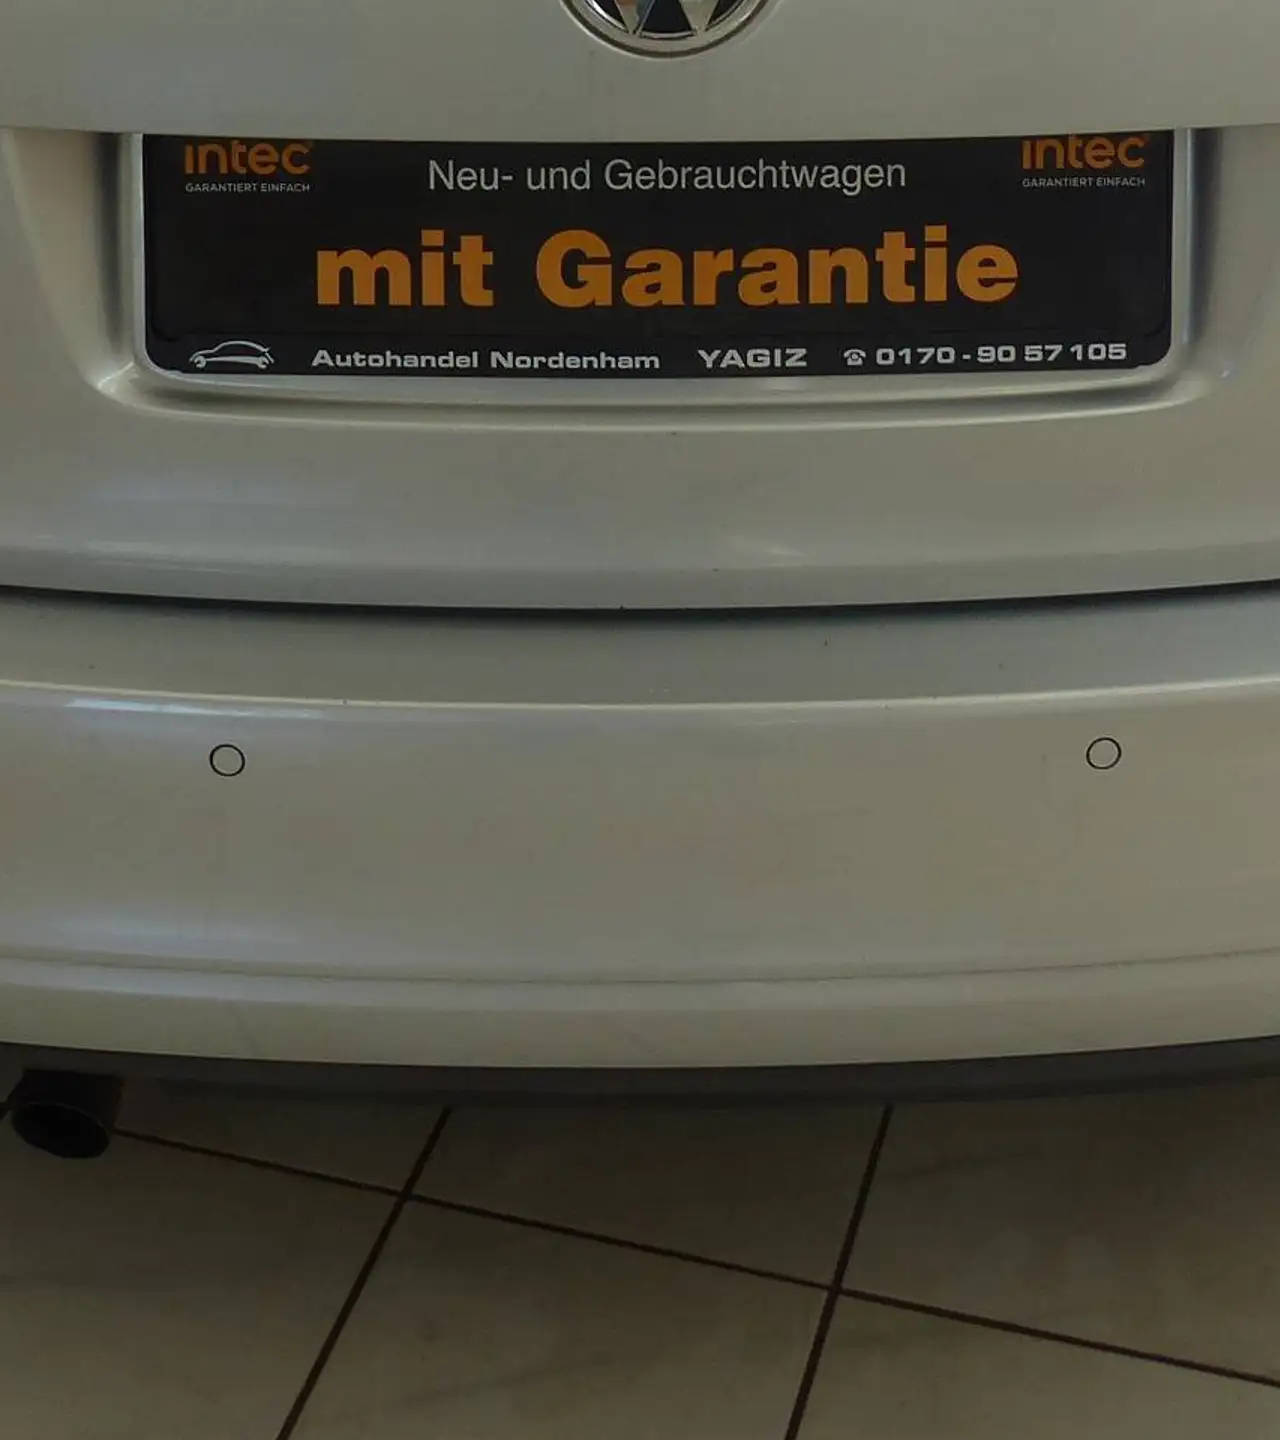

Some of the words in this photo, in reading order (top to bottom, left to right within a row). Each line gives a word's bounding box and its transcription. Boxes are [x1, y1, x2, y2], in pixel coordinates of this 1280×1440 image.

[185, 182, 257, 193] GARANTIERT
[260, 182, 310, 193] EINFACH
[428, 159, 513, 191] Neu-
[526, 159, 591, 191] und
[604, 159, 907, 196] Gebrauchtwagen
[1022, 177, 1093, 188] GARANTIERT
[1095, 176, 1146, 187] EINFACH
[317, 229, 495, 307] mit
[535, 225, 1019, 308] Garantie
[311, 349, 478, 369] Autohandel
[490, 351, 660, 370] Nordenham
[697, 348, 808, 369] YAGIZ
[875, 348, 956, 366] 0170
